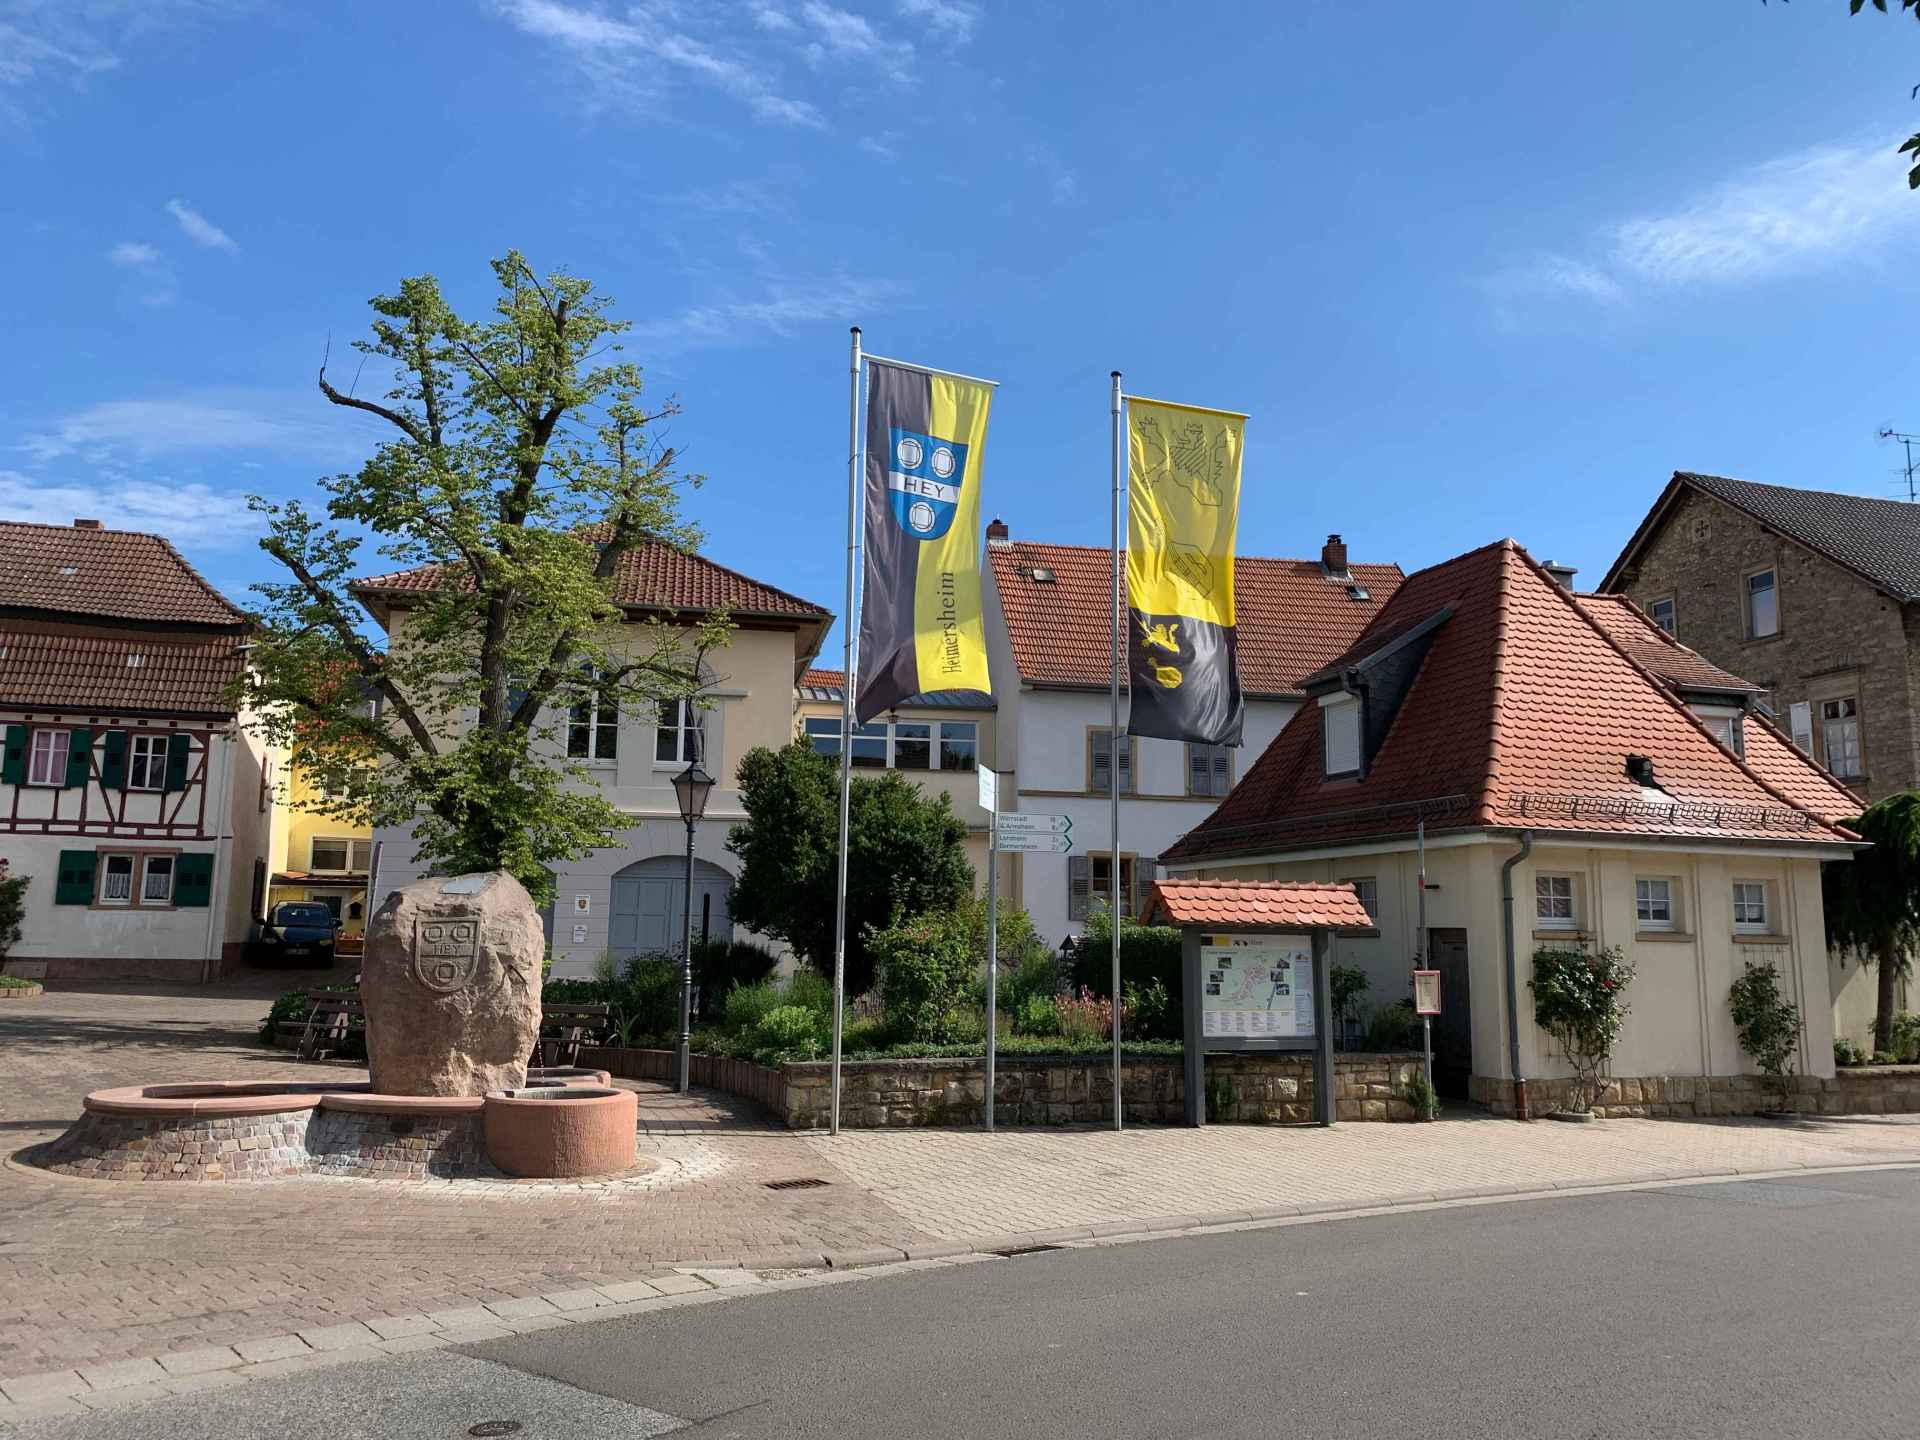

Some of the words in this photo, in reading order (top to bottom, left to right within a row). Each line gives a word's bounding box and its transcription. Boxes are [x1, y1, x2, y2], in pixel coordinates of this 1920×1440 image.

[904, 477, 944, 498] HEY
[936, 572, 963, 673] Heimersheim
[433, 944, 461, 955] HEY
